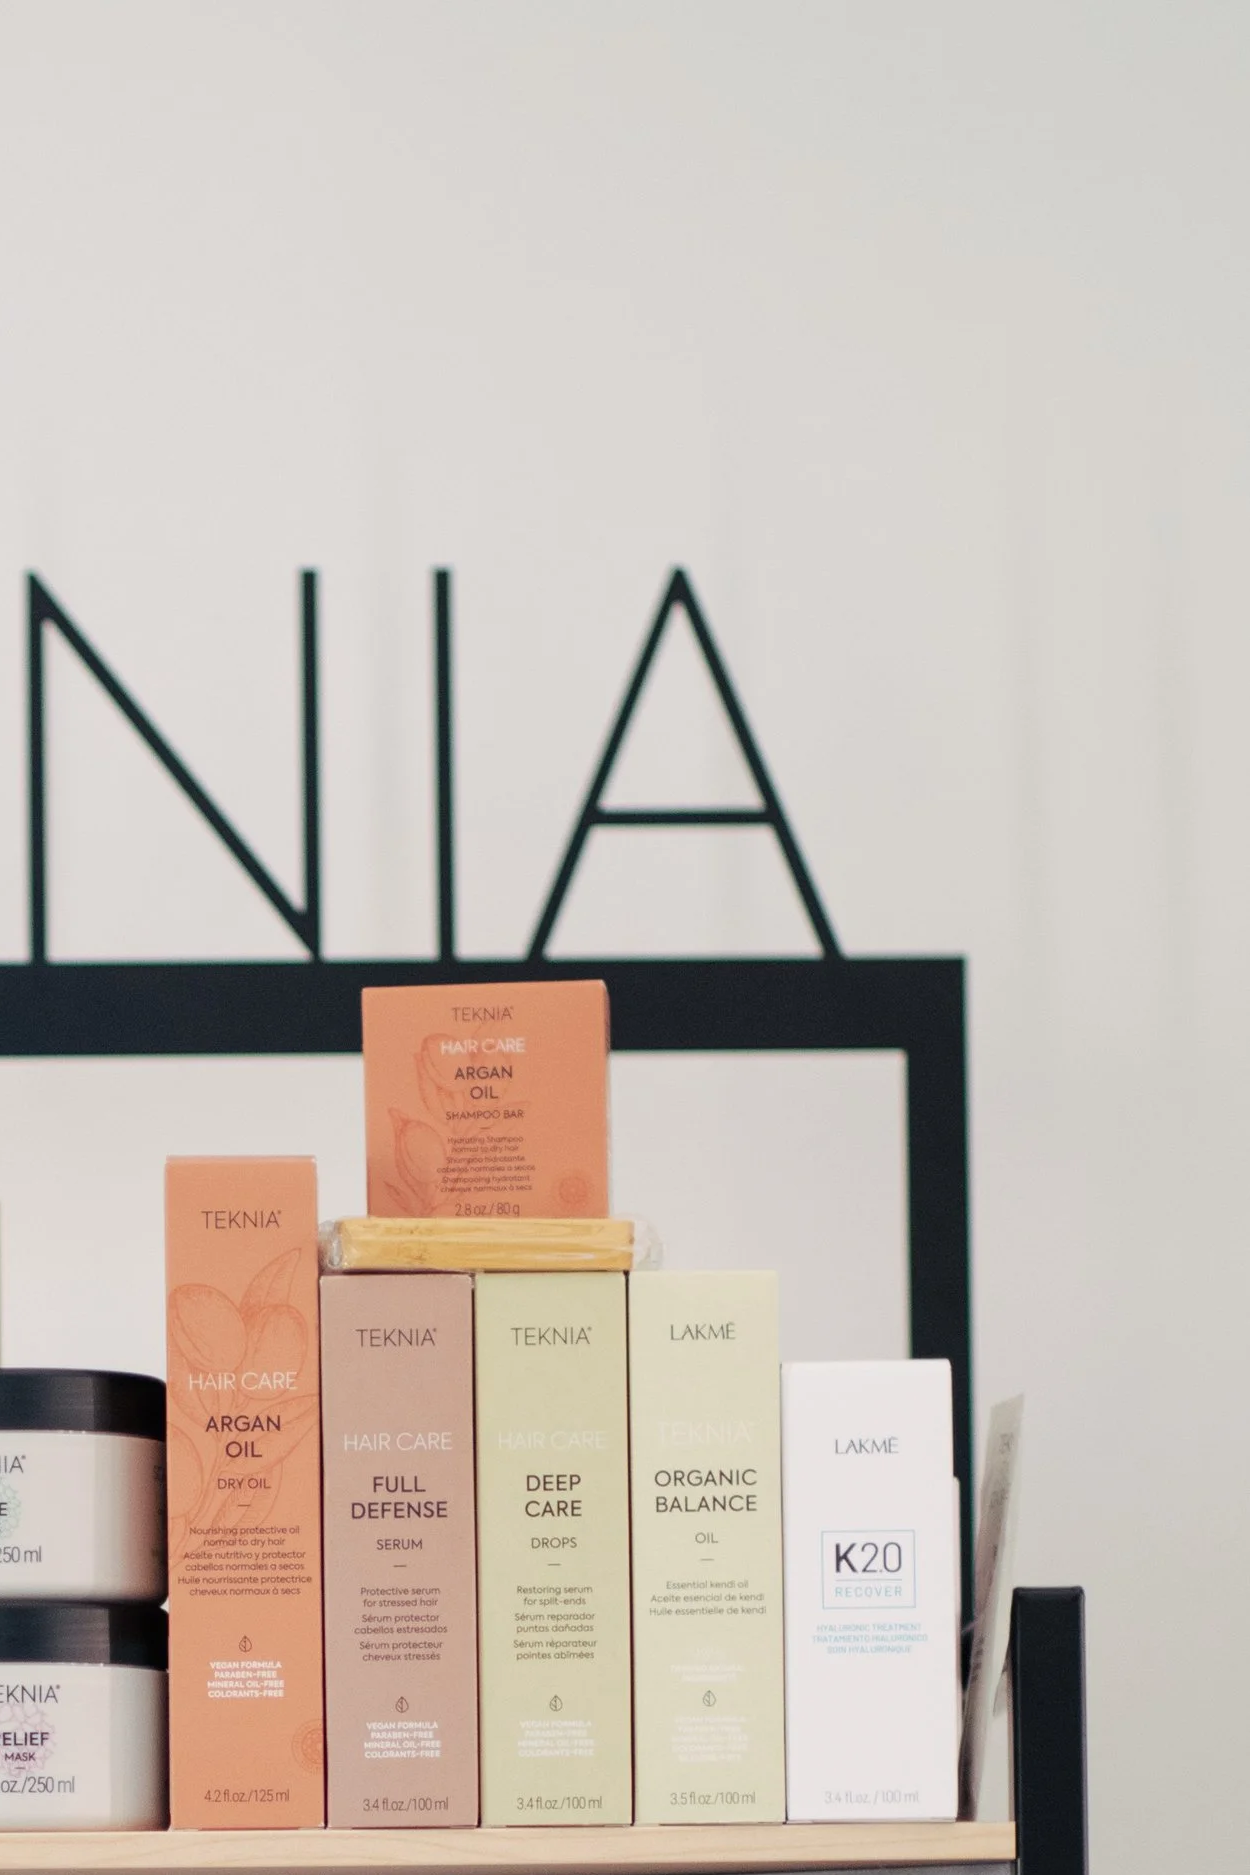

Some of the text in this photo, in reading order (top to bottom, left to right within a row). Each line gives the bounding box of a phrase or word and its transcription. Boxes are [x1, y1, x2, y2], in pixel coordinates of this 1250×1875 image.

[440, 1038, 526, 1055] HAIR CARE
[454, 1064, 514, 1081] ARGAN
[469, 1085, 499, 1100] OIL
[445, 1107, 525, 1120] SHAMPOO BAR
[187, 1370, 298, 1392] HAIR CARE
[204, 1413, 282, 1434] ARGAN
[225, 1439, 264, 1460] OIL
[343, 1431, 454, 1453] HAIR CARE
[217, 1478, 272, 1489] DRY OIL
[371, 1474, 426, 1495] FULL
[525, 1474, 582, 1494] DEEP
[653, 1467, 759, 1489] ORGANIC
[350, 1499, 449, 1520] DEFENSE
[523, 1498, 583, 1520] CARE
[654, 1493, 759, 1514] BALANCE
[189, 1526, 301, 1536] Nourishing protective oil
[694, 1531, 720, 1545] OIL
[203, 1537, 286, 1548] normal to dry hair
[375, 1537, 424, 1552] SERUM
[530, 1536, 578, 1550] DROPS
[360, 1587, 409, 1596] Protective
[834, 1584, 903, 1600] RECOVER
[361, 1597, 440, 1607] for stressed hair
[209, 1660, 284, 1670] VEGAN FORMULA
[213, 1669, 279, 1680] PARABEN-FREE
[3, 1751, 37, 1764] MASK
[56, 1773, 77, 1796] ml
